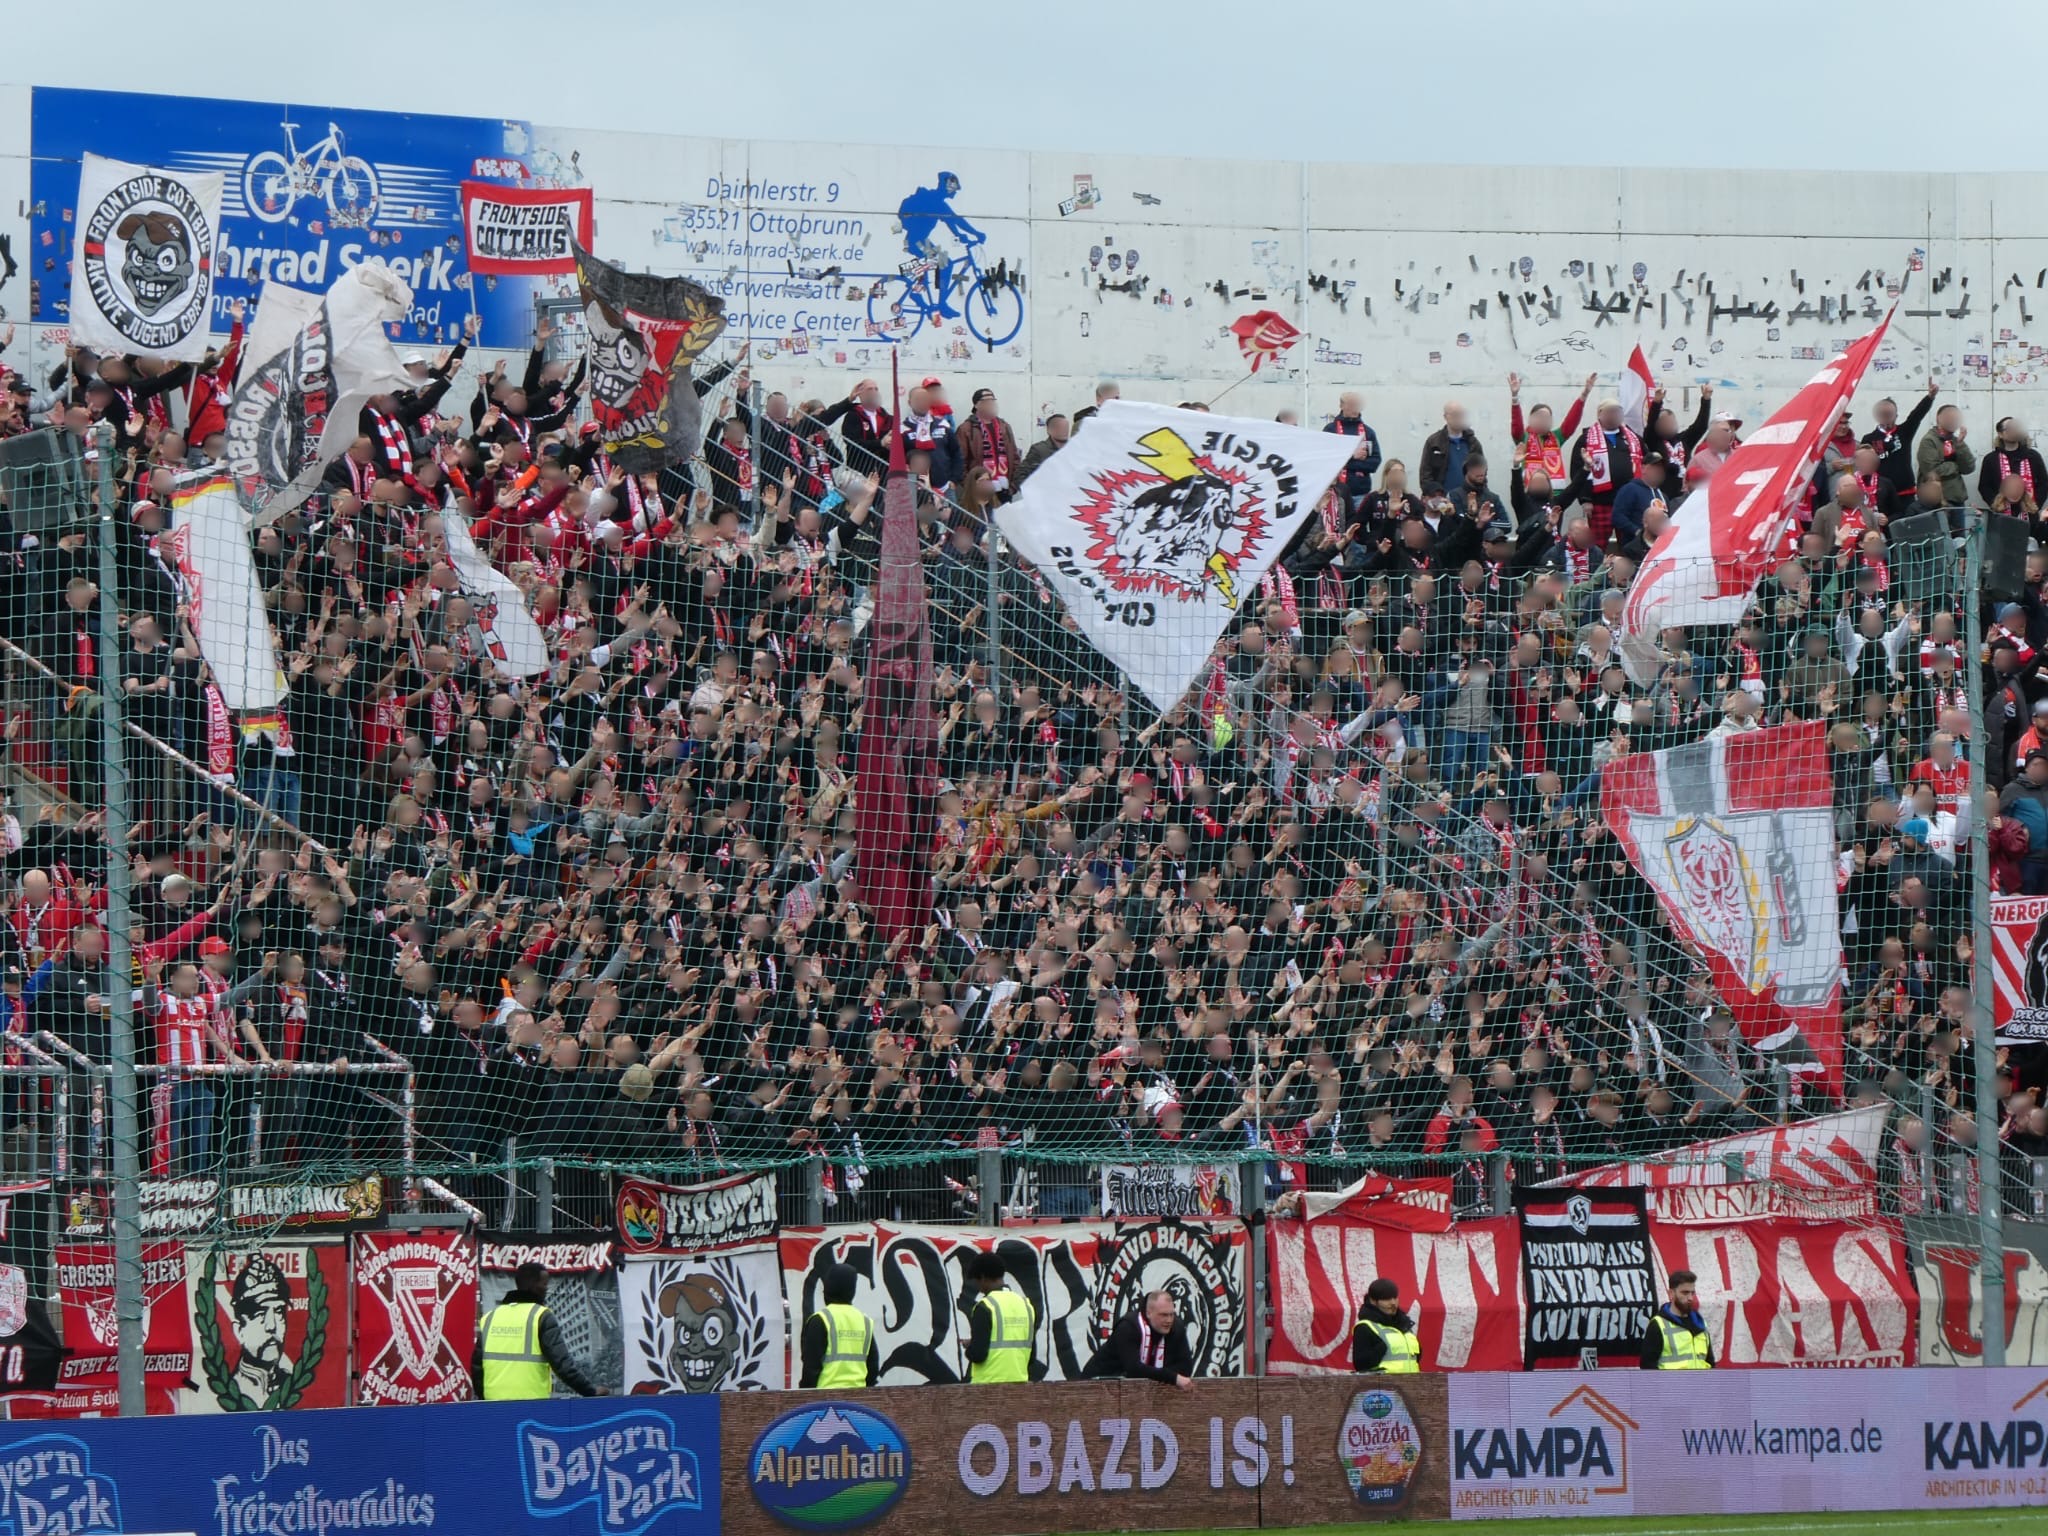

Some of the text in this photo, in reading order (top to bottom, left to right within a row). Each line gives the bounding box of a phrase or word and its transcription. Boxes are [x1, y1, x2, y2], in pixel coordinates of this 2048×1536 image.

[706, 178, 840, 203] Daimlerstr. 9
[88, 177, 163, 241] FRONTSIDE
[479, 202, 568, 226] FRONTSIDE
[749, 212, 864, 237] Ottobrunn
[476, 225, 567, 254] COTTBUS
[685, 239, 865, 263] www.fahrrad-sperk.de
[213, 232, 329, 284] hrrad
[86, 258, 127, 325] AKTIVE
[123, 317, 179, 346] JUGEND
[676, 272, 841, 301] isterwerkstatt
[720, 308, 864, 331] ervice Center
[1990, 901, 2048, 922] NERGI
[659, 1172, 778, 1235] VERBOTEN
[228, 1252, 300, 1275] ERGIE
[481, 1240, 614, 1270] ENERGIEBEZIRK
[1526, 1240, 1646, 1268] PSEUDOFANS
[60, 1258, 182, 1288] GROSSRHEN
[1530, 1267, 1653, 1303] ENERGIE
[1157, 1225, 1223, 1290] BIANCO
[1205, 1294, 1232, 1378] ROSSO
[1532, 1305, 1653, 1342] COTTBUS
[64, 1356, 103, 1379] STEHT
[143, 1353, 189, 1372] ERGIE!
[1348, 1421, 1410, 1448] Obazda
[1683, 1419, 1883, 1463] www.kampa.de
[251, 1424, 310, 1482] Das
[527, 1425, 670, 1500] Bayern
[755, 1447, 905, 1489] Alpenhain
[958, 1415, 1295, 1497] OBAZD IS!
[1454, 1426, 1615, 1480] KAMPA
[604, 1453, 696, 1526] Park
[1456, 1486, 1540, 1508] ARCHITEKTUR
[1543, 1487, 1556, 1505] IN
[1926, 1479, 2001, 1498] ARCHITEKTUR
[2004, 1479, 2017, 1495] IN
[14, 1479, 116, 1536] Park
[213, 1477, 435, 1536] Freizeitparadies
